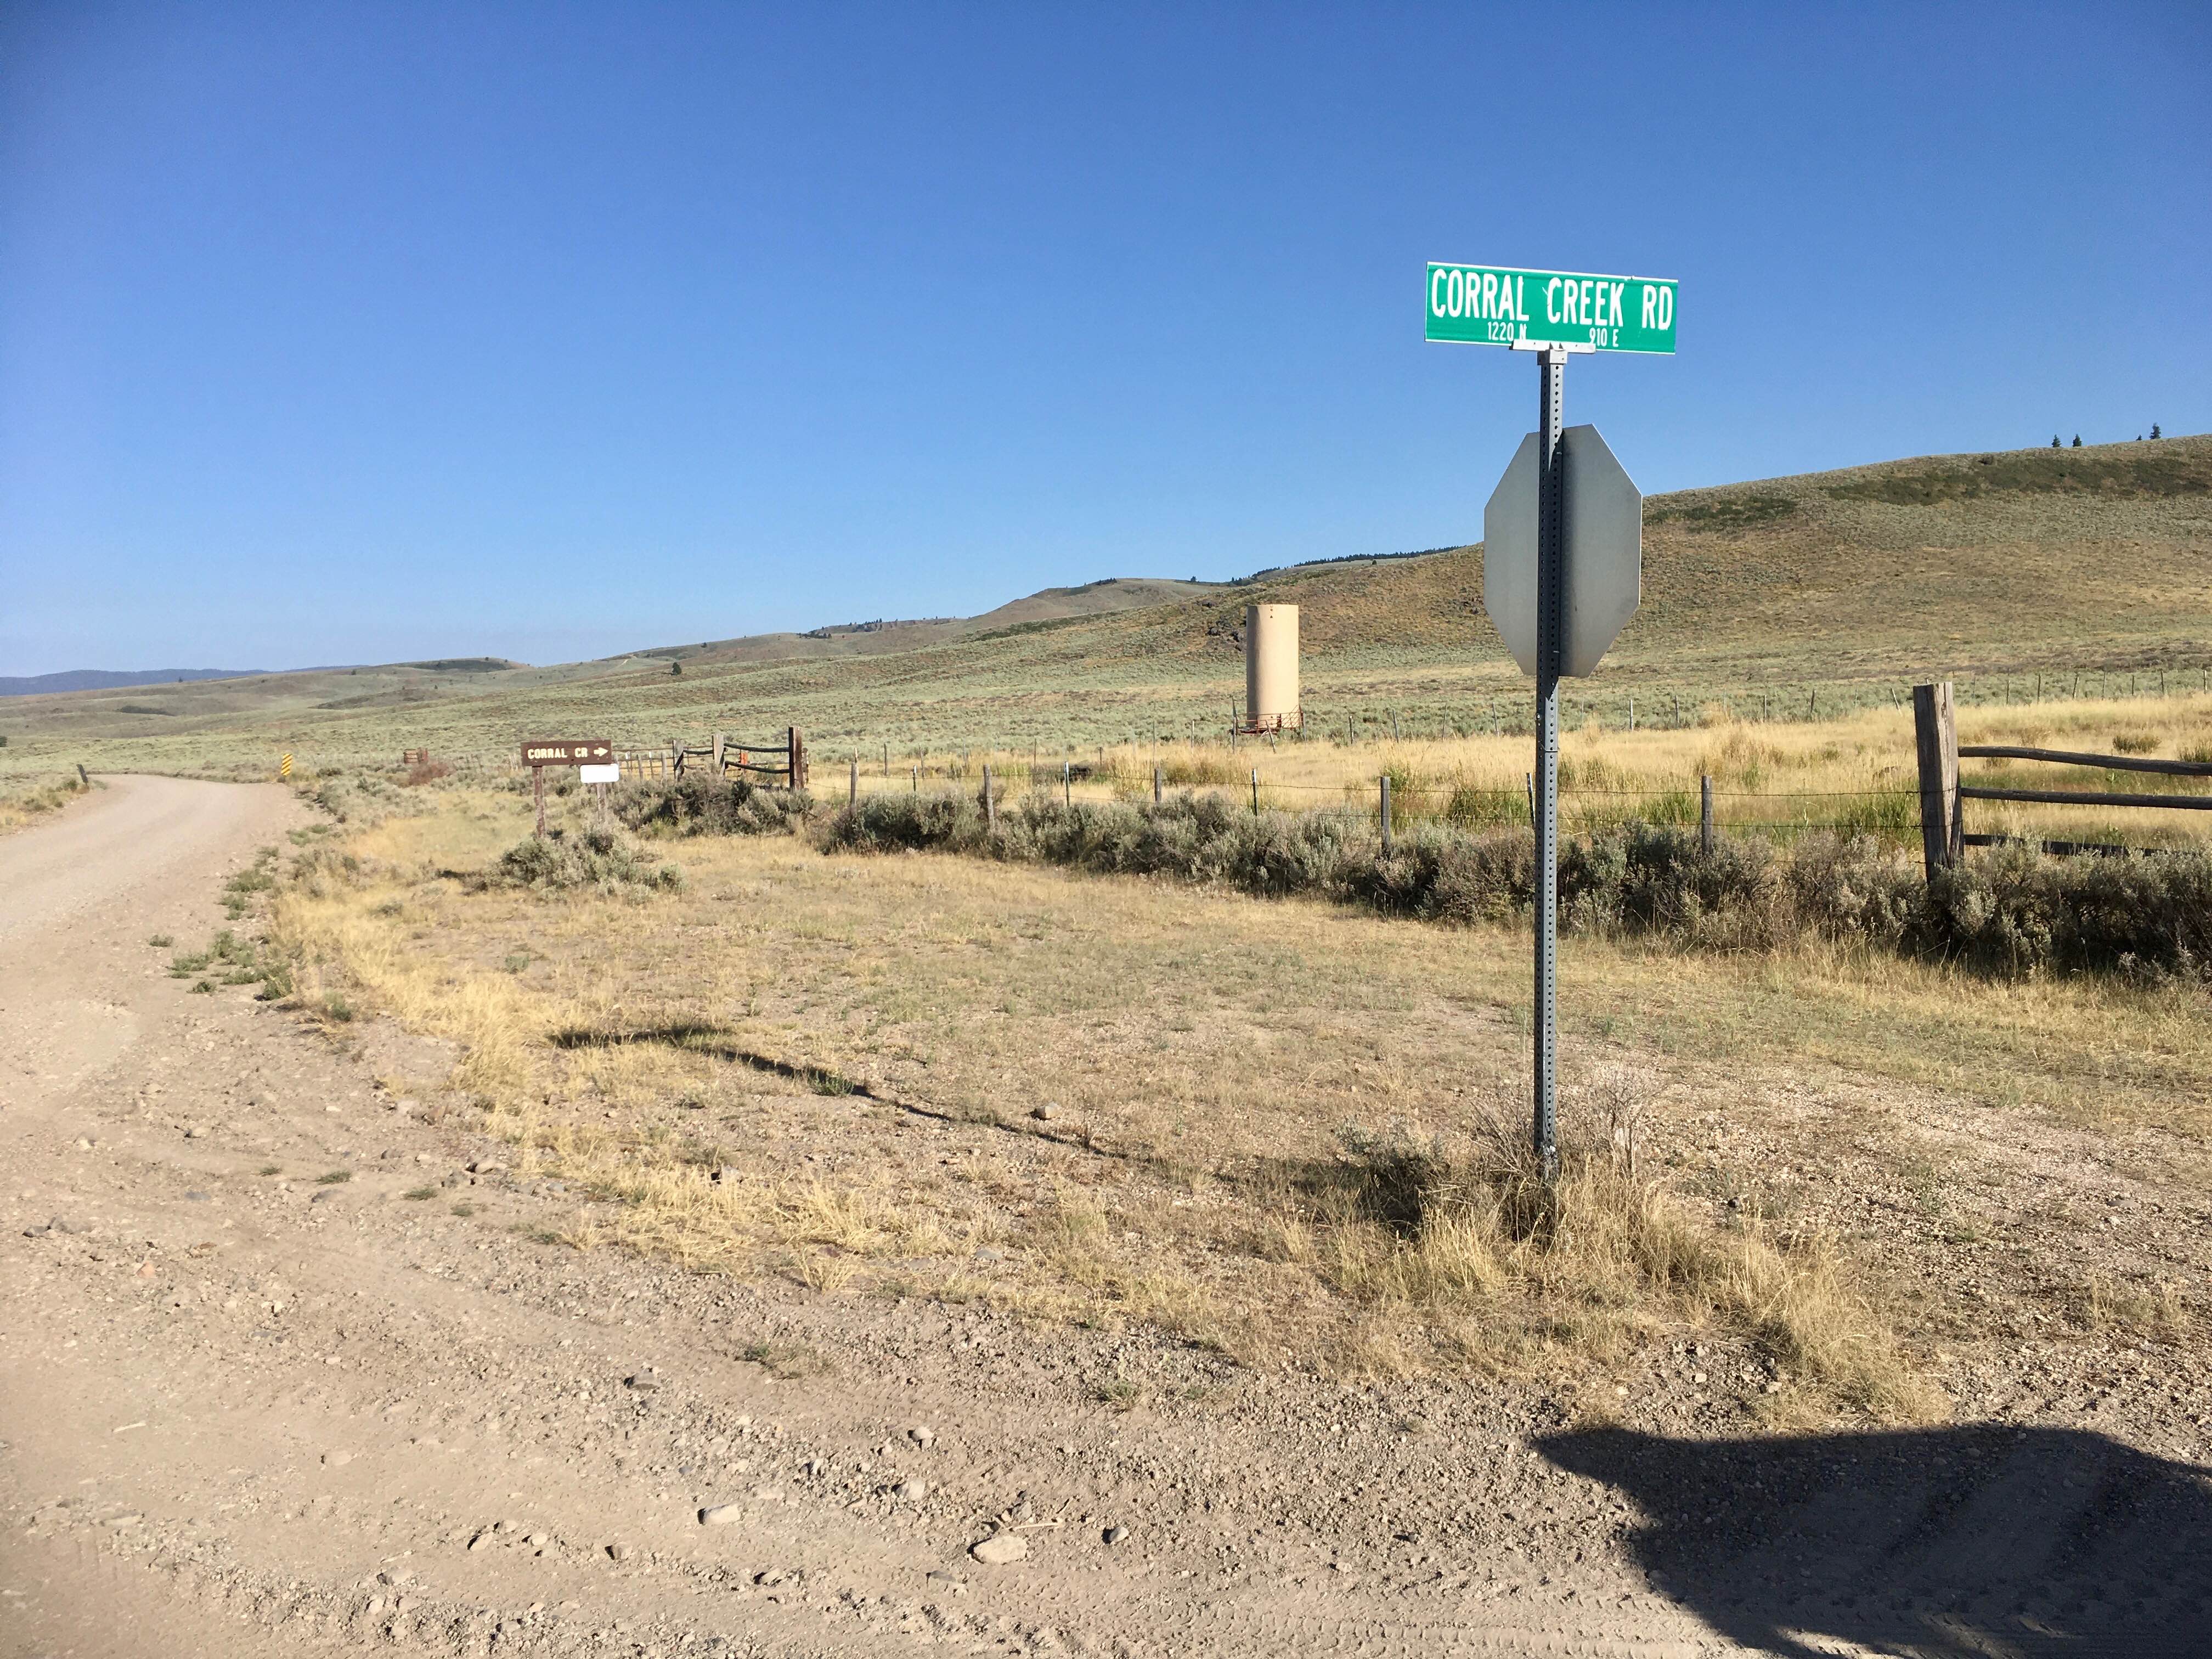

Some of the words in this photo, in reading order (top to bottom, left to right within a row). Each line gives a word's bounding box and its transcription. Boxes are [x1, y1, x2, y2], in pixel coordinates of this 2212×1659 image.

[1431, 268, 1530, 321] CORRAL
[1547, 277, 1625, 327] CREEK
[1641, 284, 1673, 331] RD
[1487, 321, 1514, 342] 1220
[1519, 324, 1527, 341] N
[1589, 328, 1608, 347] 910
[1612, 329, 1619, 347] E
[527, 748, 568, 759] CORRAL
[574, 747, 588, 758] CR
